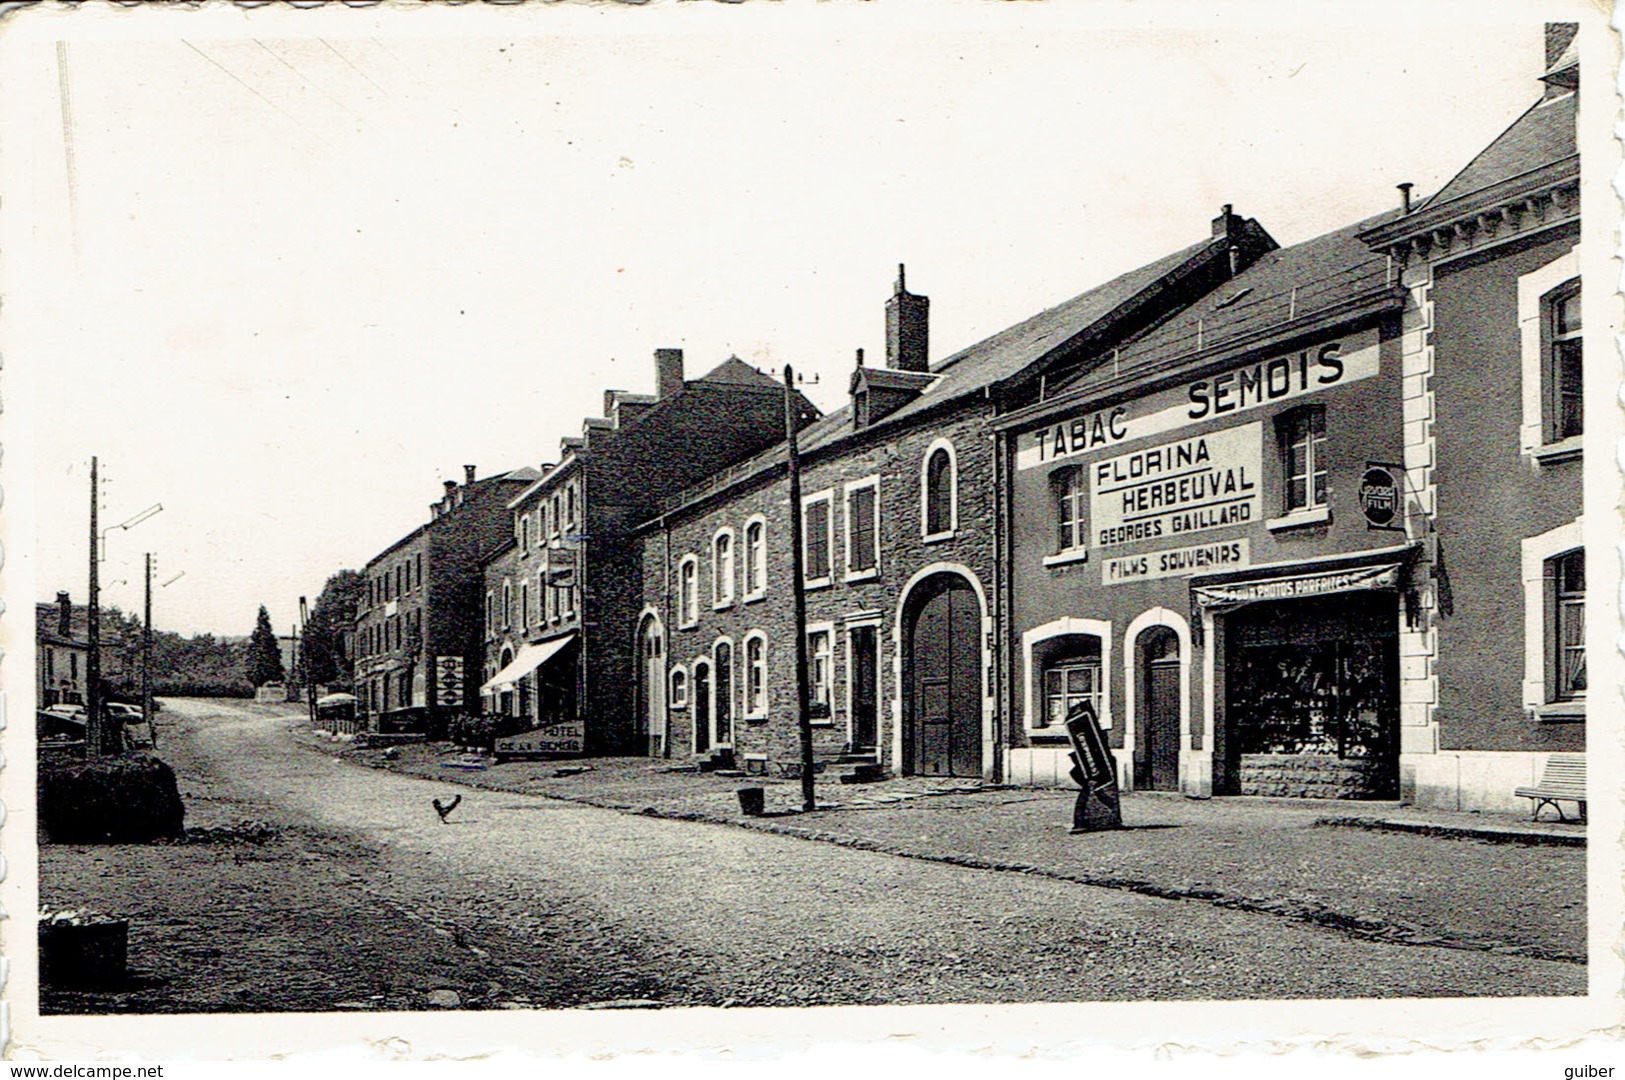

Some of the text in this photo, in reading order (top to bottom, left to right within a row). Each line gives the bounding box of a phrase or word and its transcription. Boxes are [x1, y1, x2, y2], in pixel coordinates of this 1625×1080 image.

[1035, 343, 1344, 461] TABAC SEMOIS
[1098, 439, 1210, 486] FLORINA
[1123, 466, 1254, 514] HERBEUVAL
[1367, 499, 1392, 509] FILM
[1100, 502, 1250, 545] GEORGES GAILLARD
[1110, 543, 1240, 579] FILMS SOUVENIRS
[1258, 580, 1293, 598] PHOTOS
[1295, 574, 1350, 595] PARFAITES
